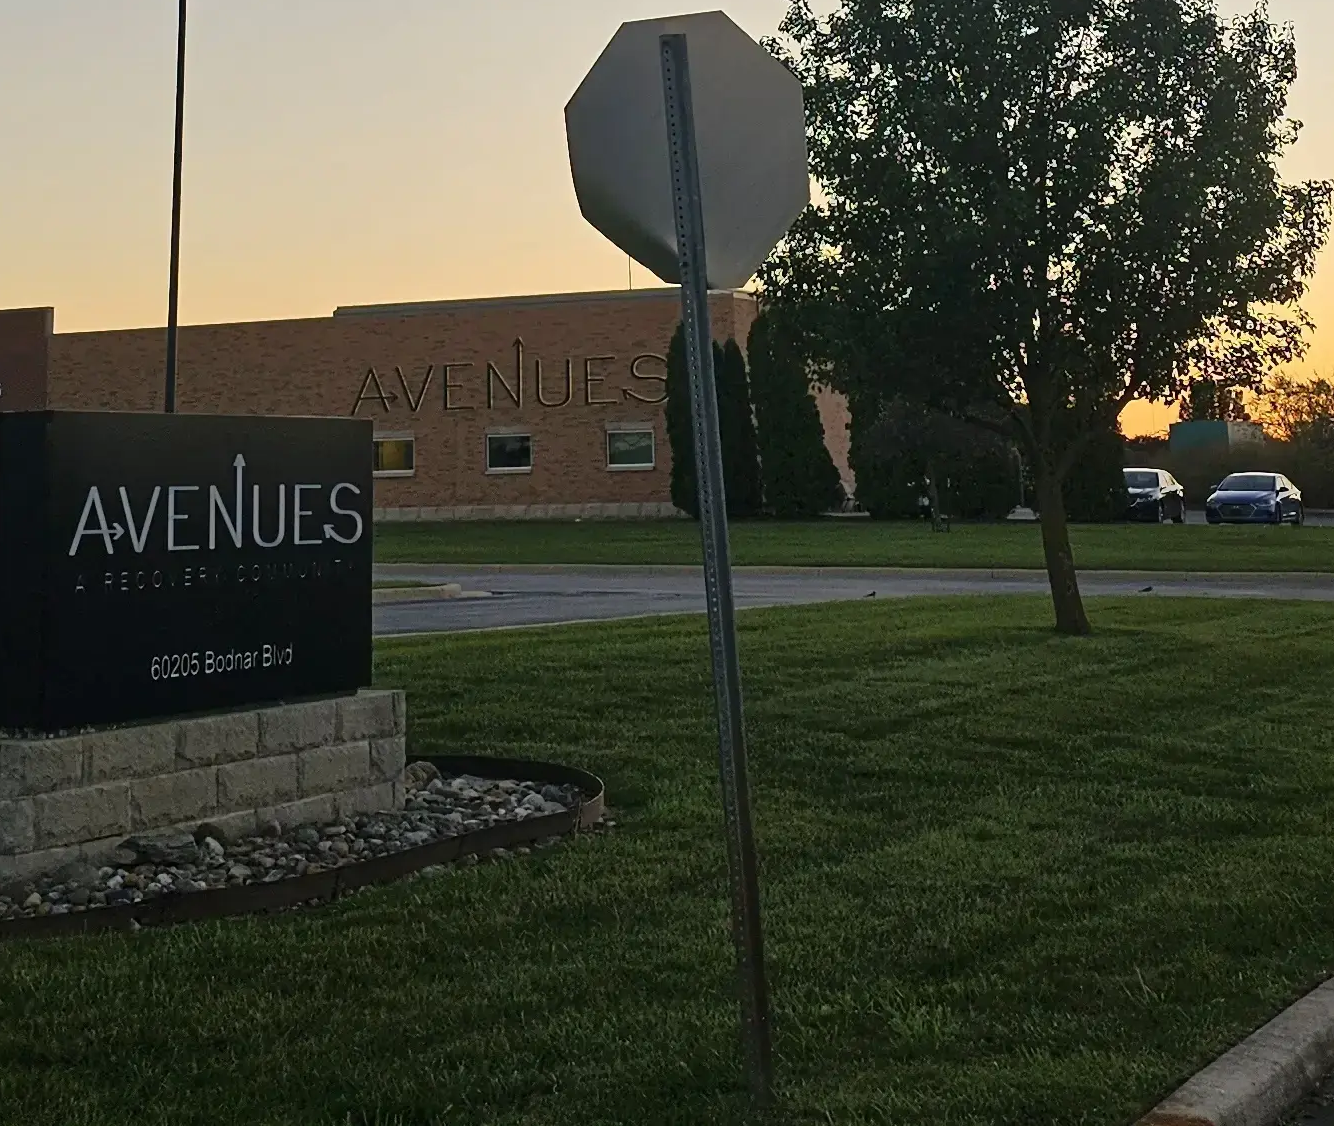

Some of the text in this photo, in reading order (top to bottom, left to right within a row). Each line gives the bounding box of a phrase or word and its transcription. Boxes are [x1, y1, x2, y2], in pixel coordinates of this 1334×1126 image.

[351, 336, 670, 416] AVENUES
[68, 454, 364, 557] AVENUES
[104, 565, 224, 593] RECOER
[150, 642, 294, 681] 60205 Bodnar Blvd
